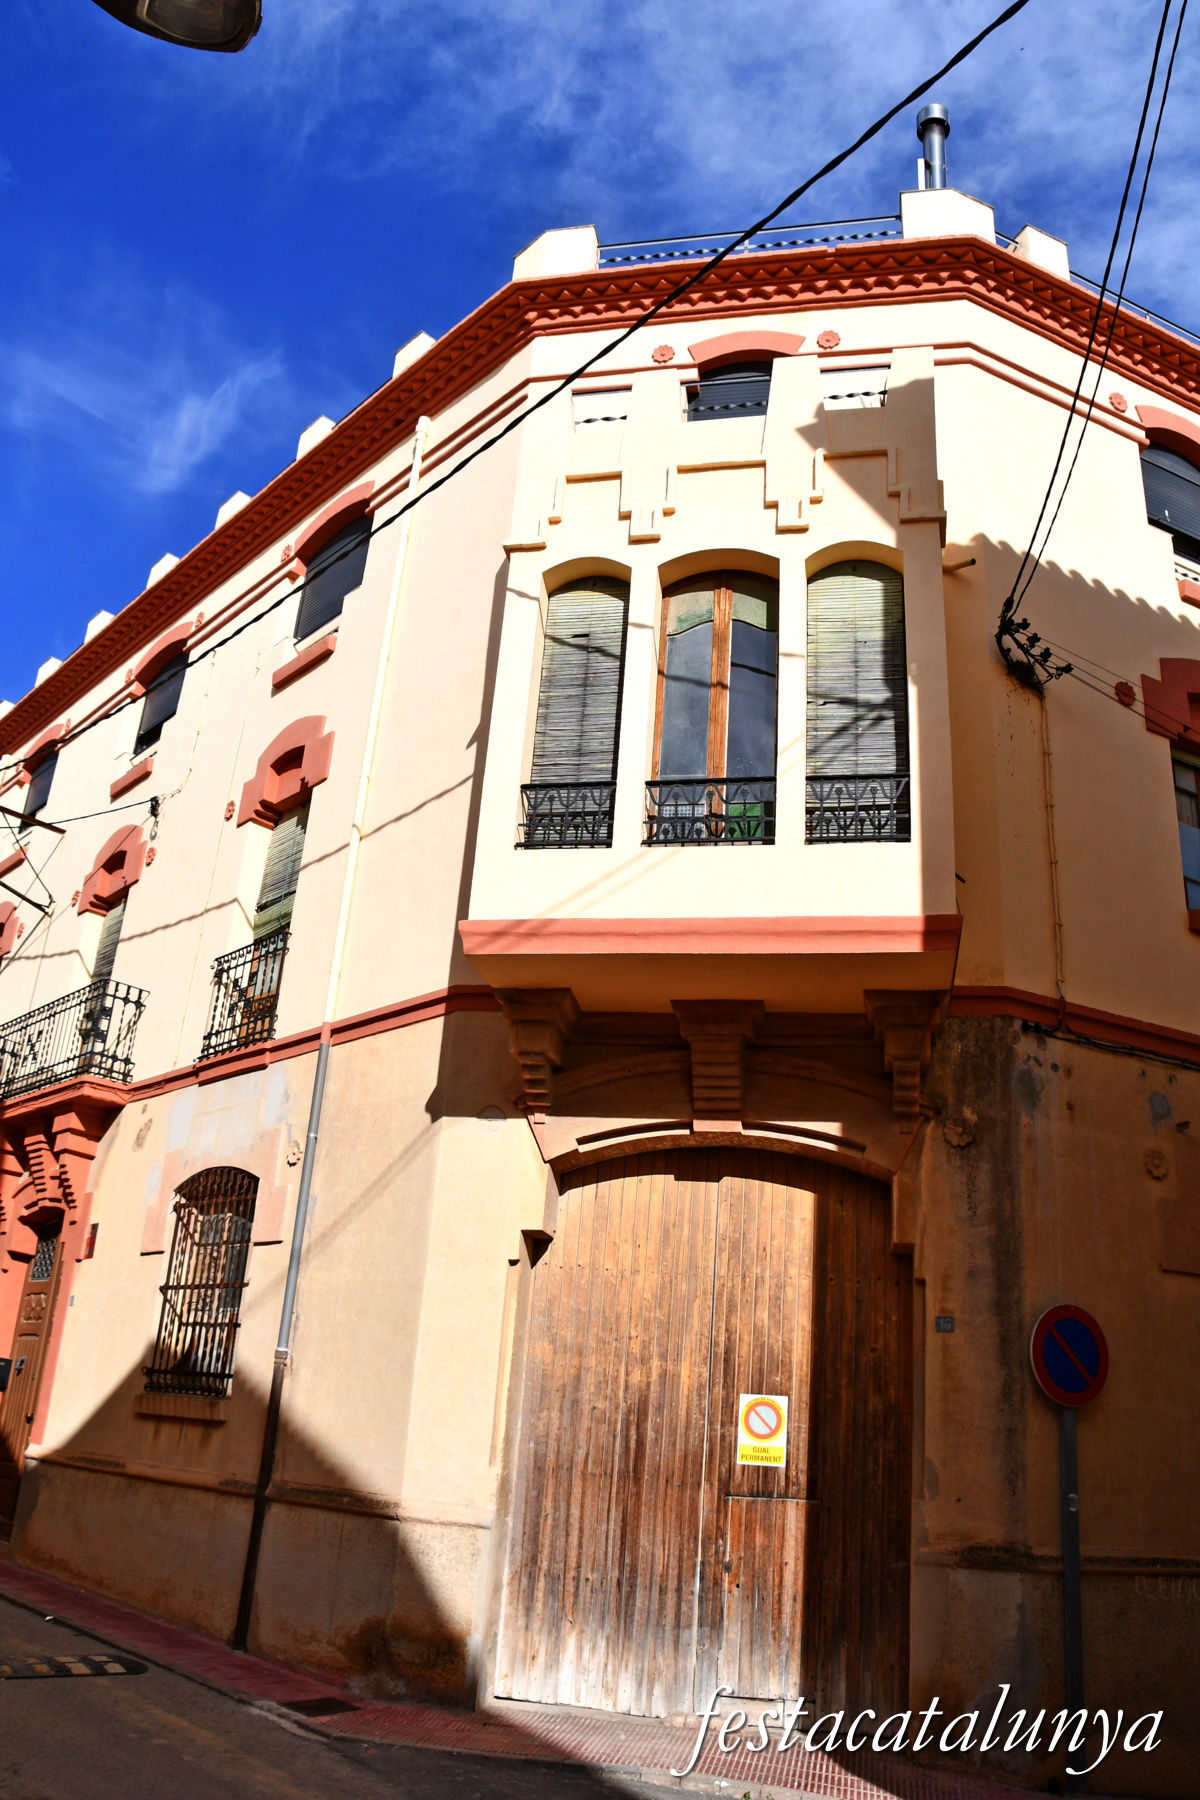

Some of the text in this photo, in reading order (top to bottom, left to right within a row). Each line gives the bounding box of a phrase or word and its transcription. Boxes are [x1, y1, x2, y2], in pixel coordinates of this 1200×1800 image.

[940, 1318, 951, 1330] 16
[753, 1446, 770, 1454] GUAL
[741, 1454, 782, 1463] PERMANENT
